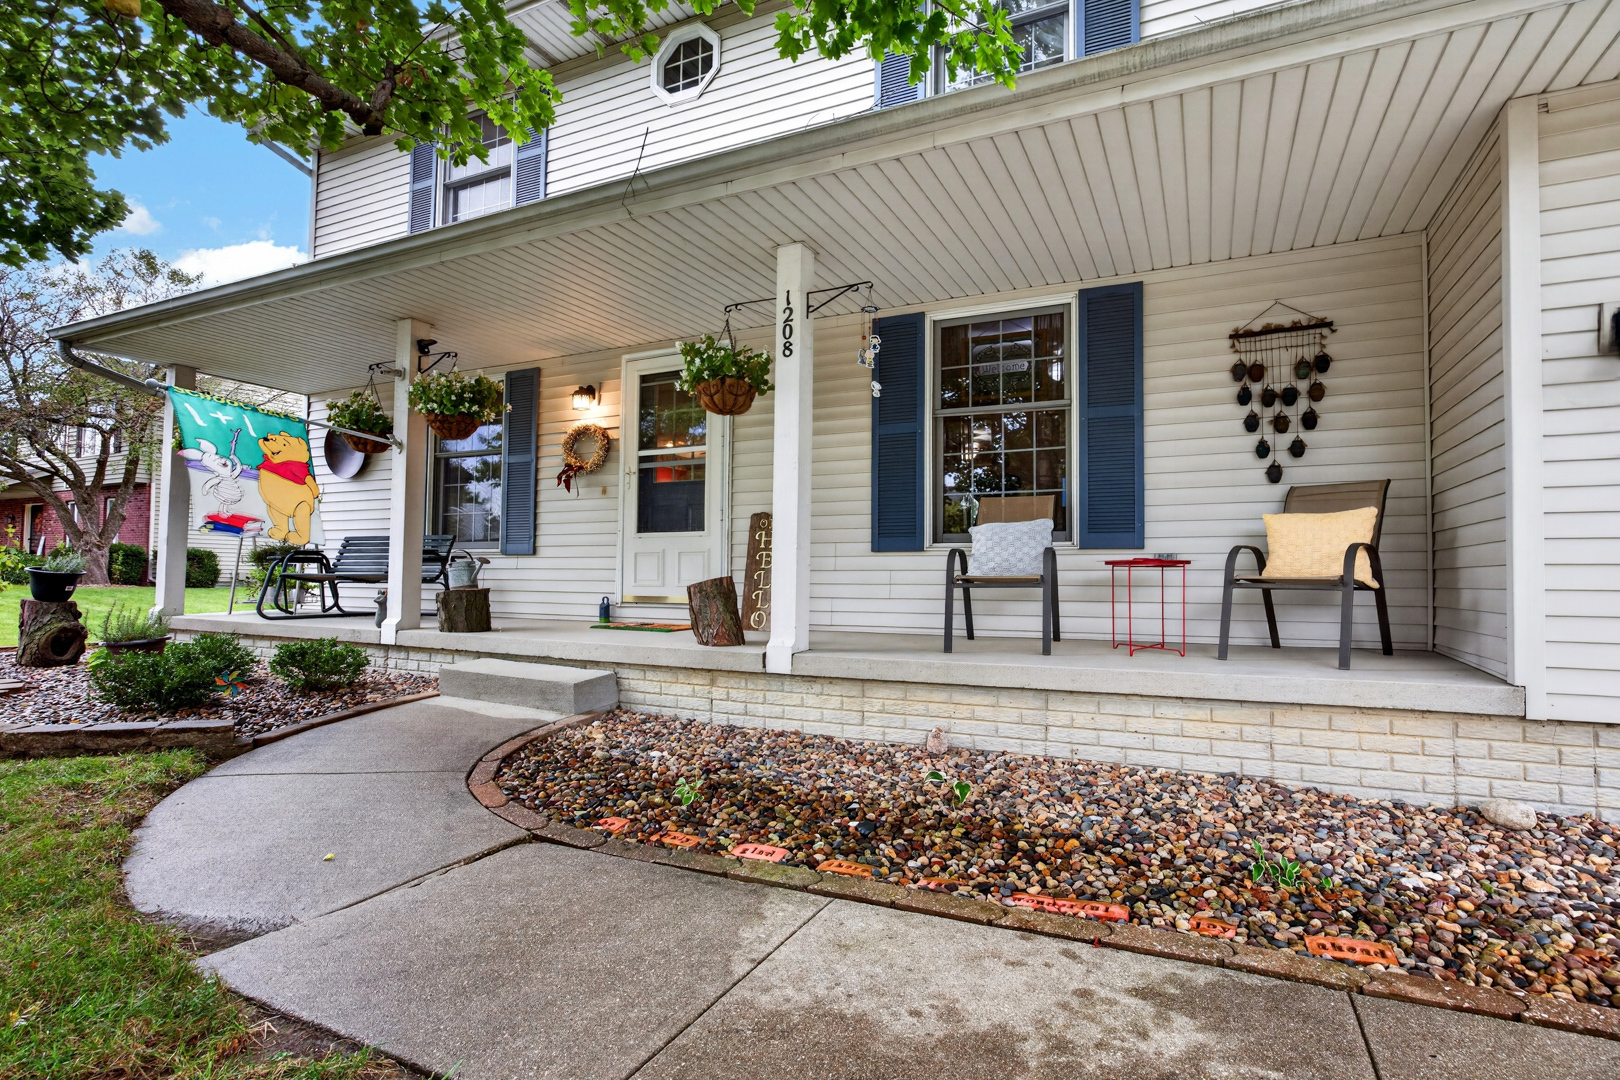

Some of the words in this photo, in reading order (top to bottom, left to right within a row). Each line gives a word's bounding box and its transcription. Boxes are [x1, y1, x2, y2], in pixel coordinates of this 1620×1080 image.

[782, 289, 794, 358] 1208
[750, 531, 773, 629] HELLO
[1316, 942, 1387, 959] ahead
